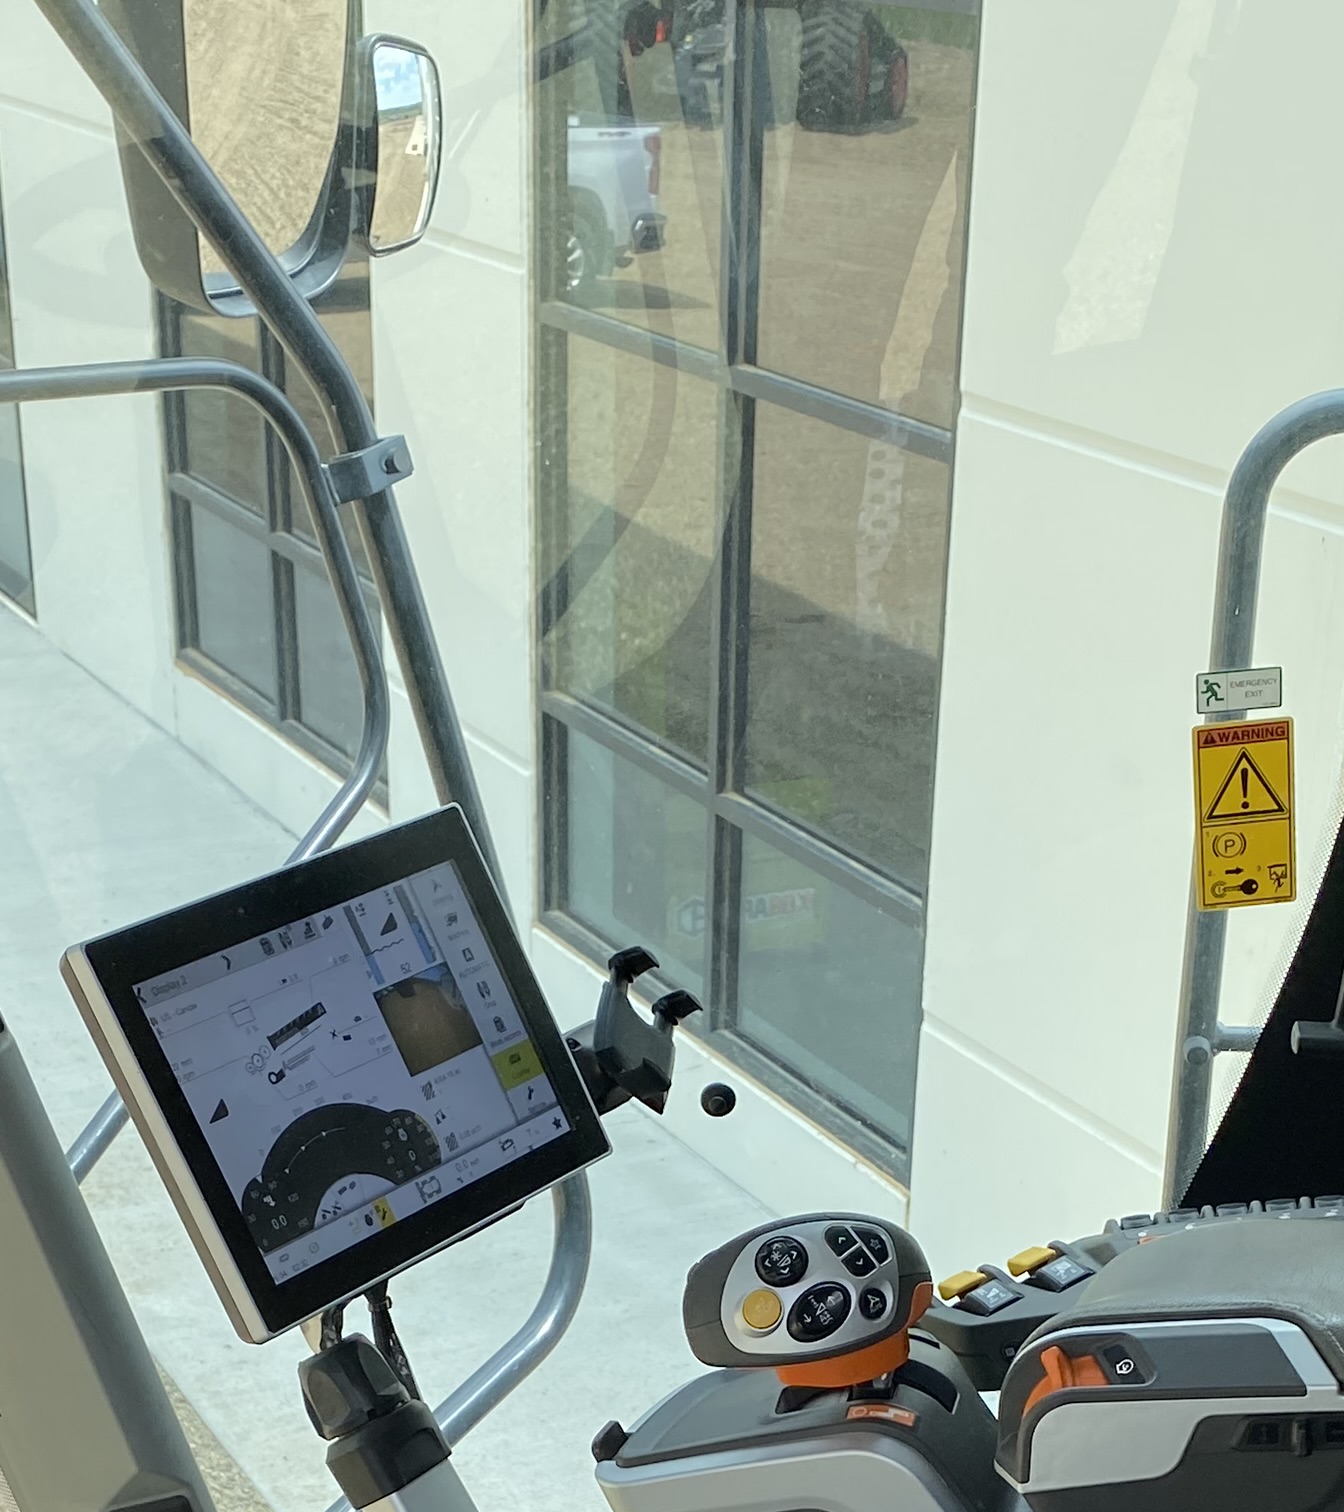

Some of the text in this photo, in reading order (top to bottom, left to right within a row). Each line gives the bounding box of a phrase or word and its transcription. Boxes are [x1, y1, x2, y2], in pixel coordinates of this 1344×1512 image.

[1229, 678, 1278, 689] EMERGENCY
[1244, 690, 1264, 699] EXIT
[1217, 725, 1286, 744] WARNING
[400, 963, 410, 973] 52
[458, 960, 490, 977] AUTOMATIC
[151, 975, 187, 996] Display 2
[408, 1150, 416, 1160] 0
[455, 1159, 468, 1172] 0.0
